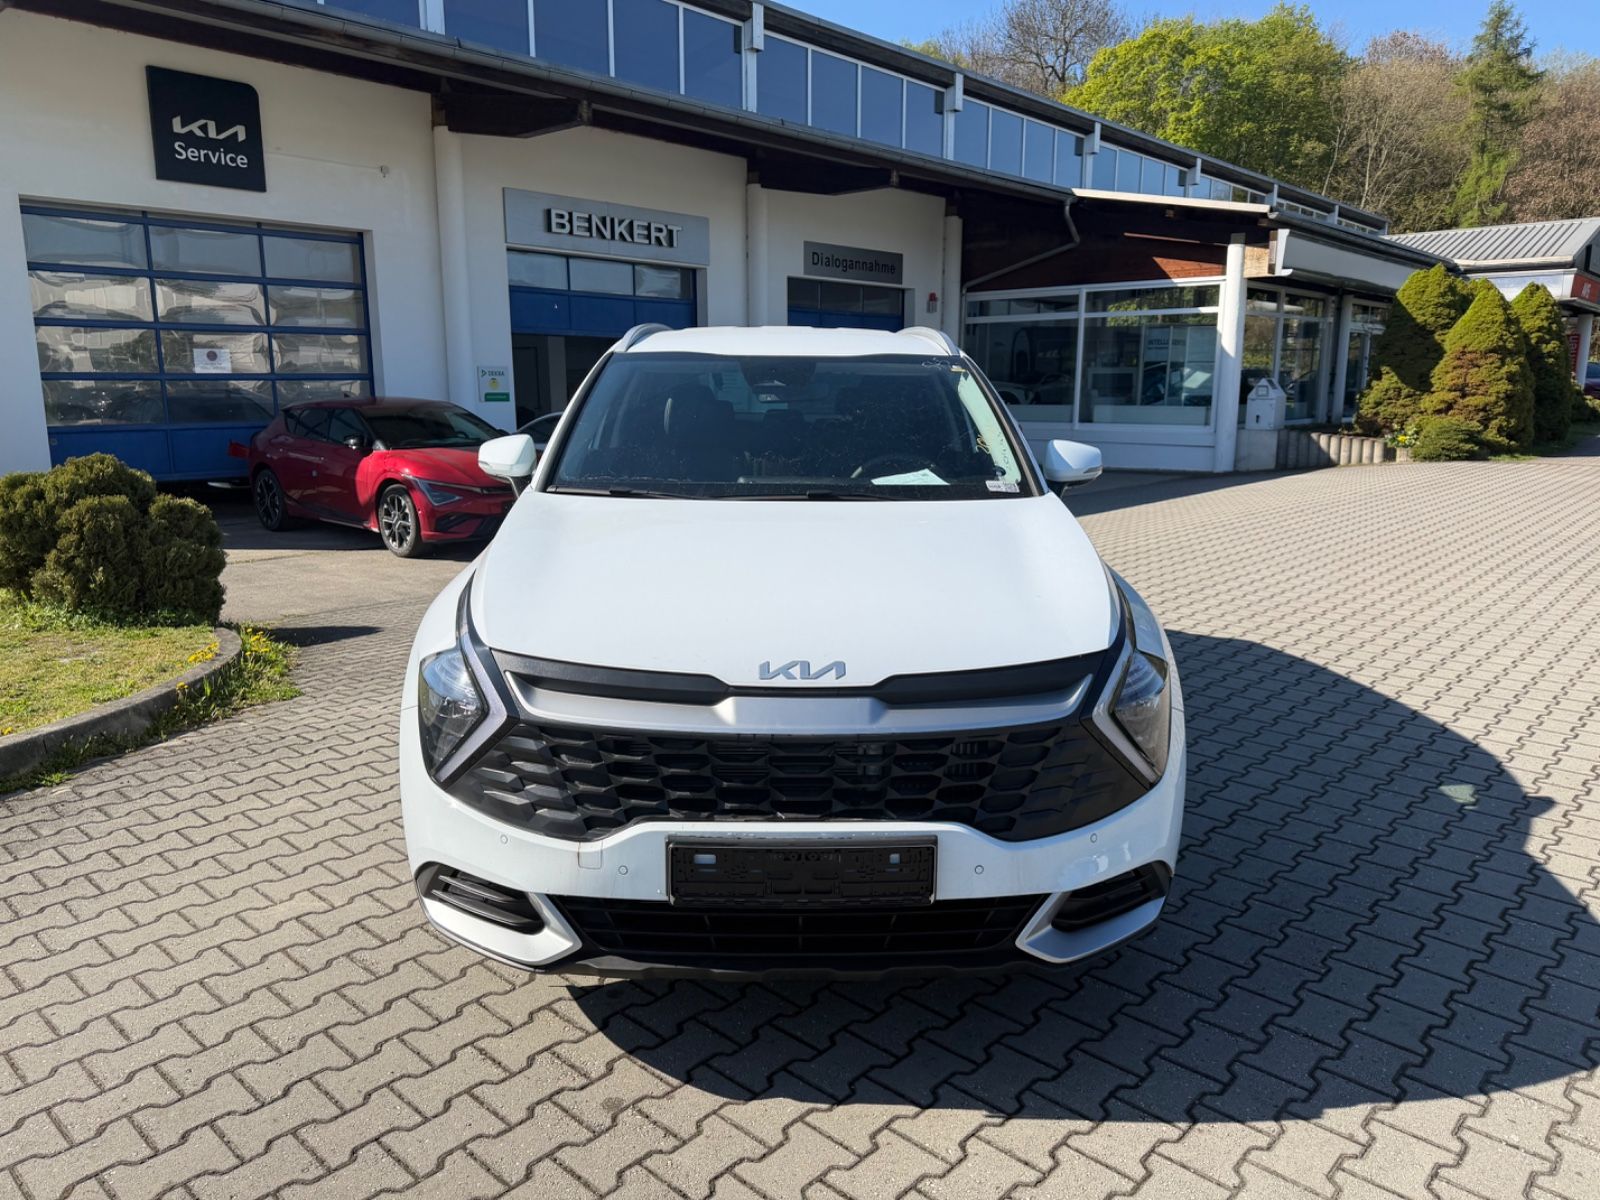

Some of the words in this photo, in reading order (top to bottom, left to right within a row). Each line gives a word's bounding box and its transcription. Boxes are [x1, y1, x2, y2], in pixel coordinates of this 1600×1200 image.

[172, 115, 246, 142] KIA
[174, 141, 249, 168] Service
[548, 207, 683, 248] BENKERT
[811, 251, 897, 275] Dialogannahme
[759, 660, 846, 680] KIA
